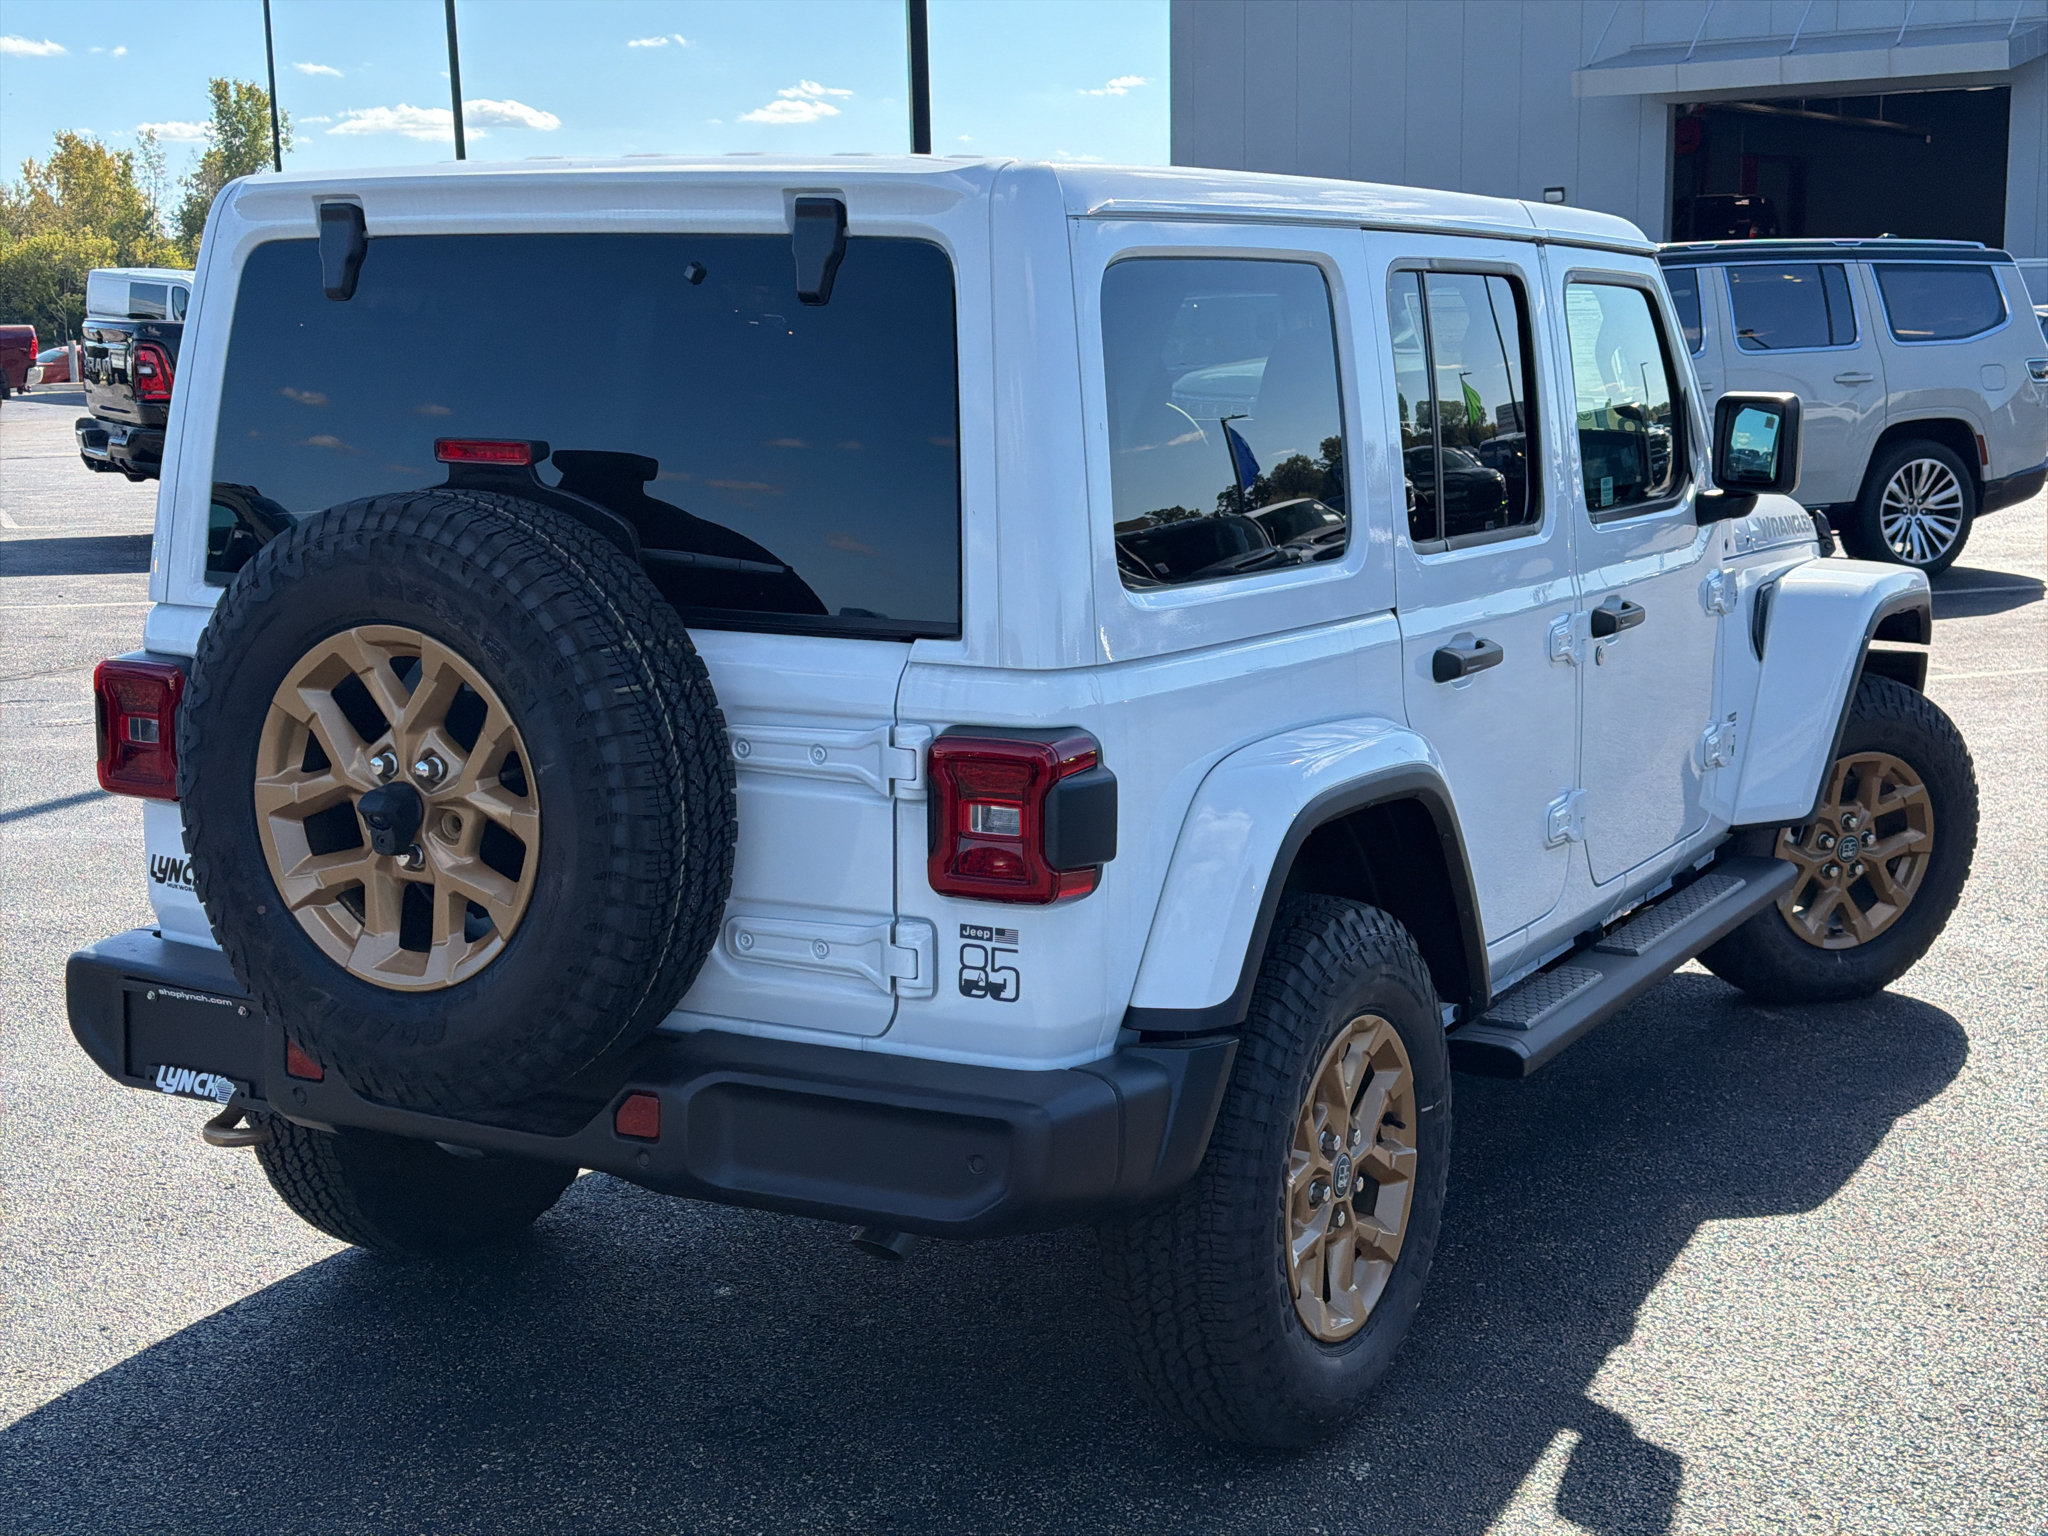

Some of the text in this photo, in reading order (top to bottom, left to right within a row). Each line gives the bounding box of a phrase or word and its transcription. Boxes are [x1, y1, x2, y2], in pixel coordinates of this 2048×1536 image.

[87, 358, 112, 375] RAM
[150, 853, 194, 885] LYNC
[962, 926, 990, 940] Jeep
[959, 943, 1020, 1002] 85
[158, 988, 233, 1007] shoplynch.com
[156, 1065, 221, 1098] LYNCH
